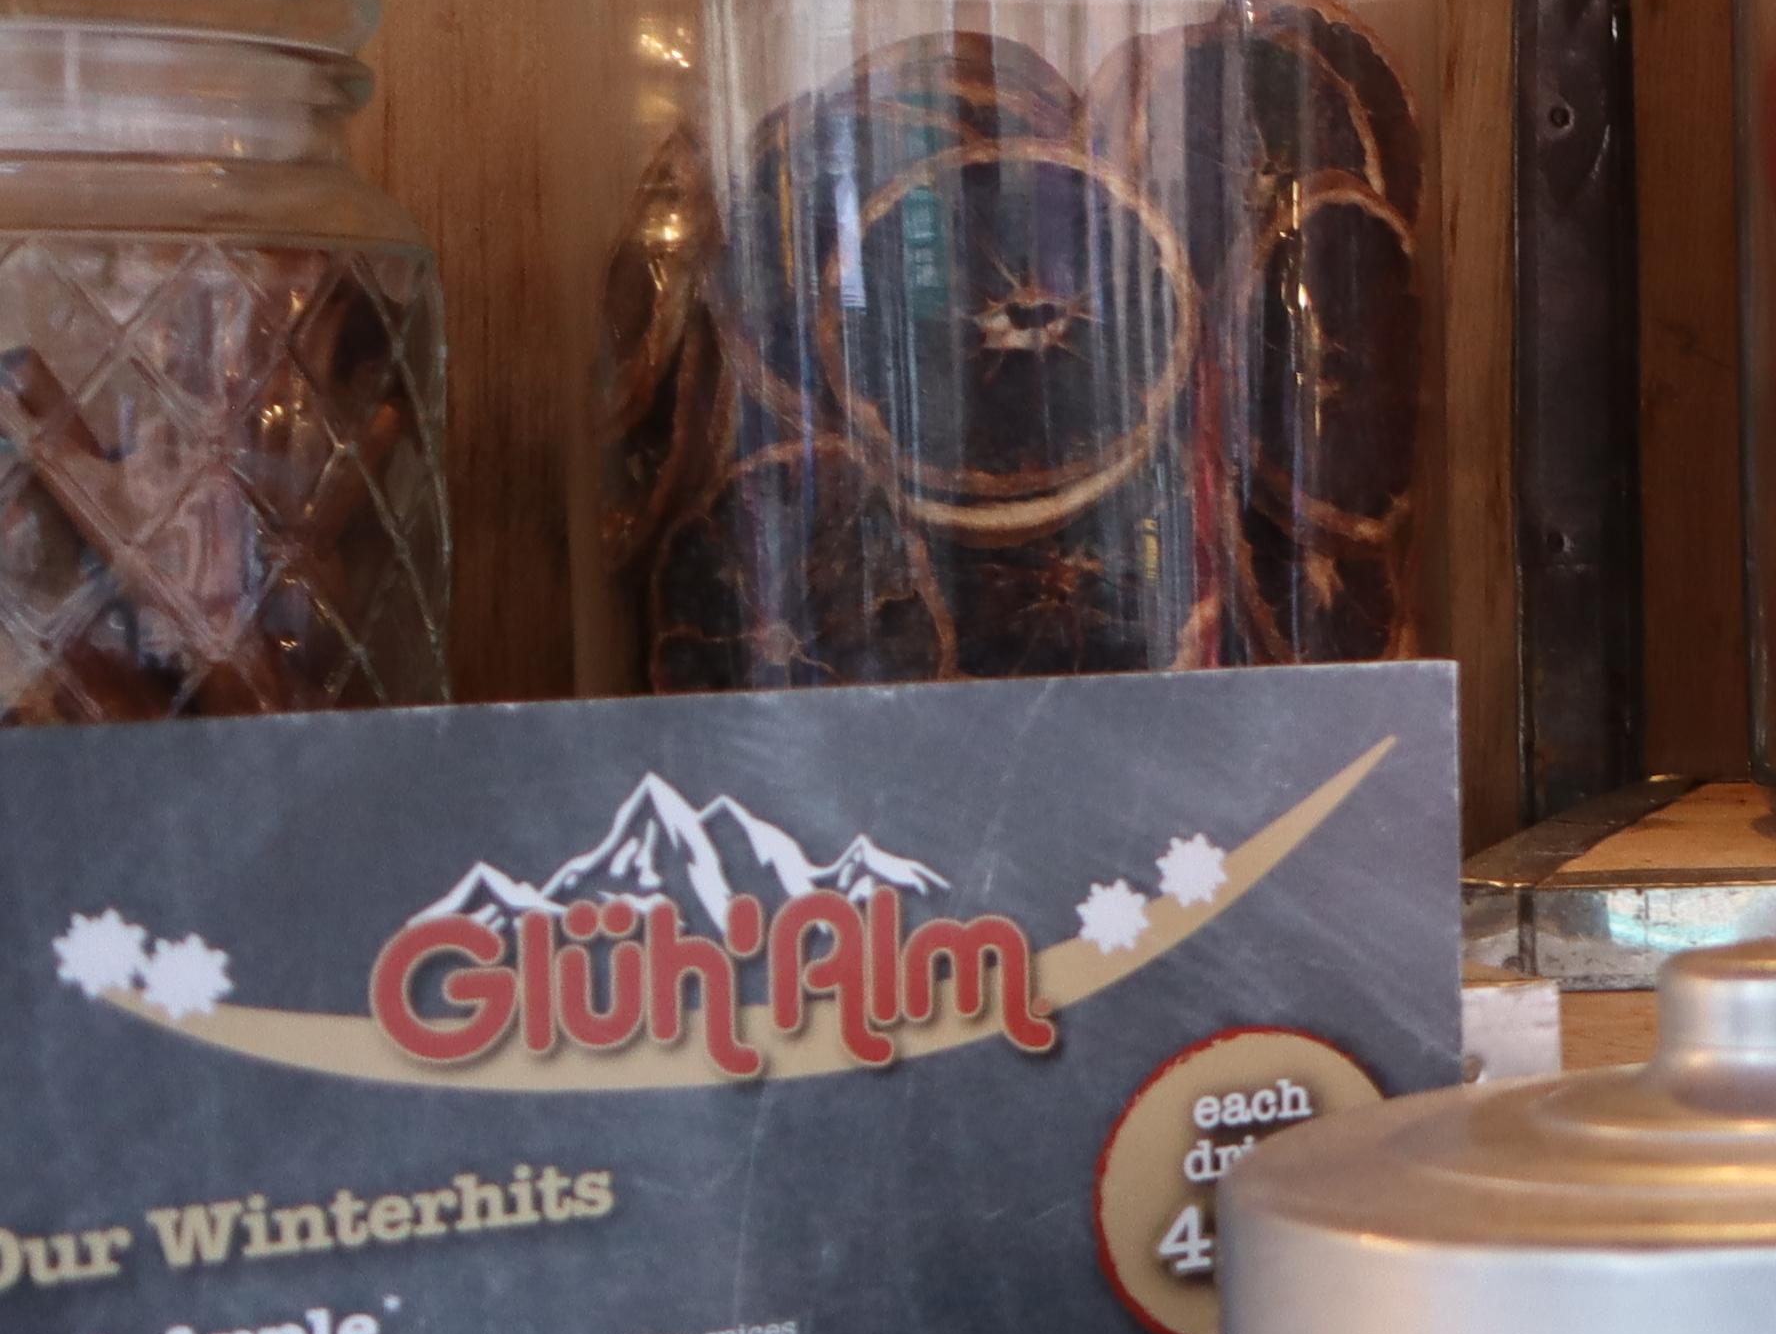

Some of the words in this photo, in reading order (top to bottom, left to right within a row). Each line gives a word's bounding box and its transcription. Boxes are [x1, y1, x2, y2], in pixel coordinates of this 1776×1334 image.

[369, 886, 1058, 1077] Glüh'Alm
[1193, 1078, 1312, 1129] each
[146, 1168, 613, 1267] Winterhits
